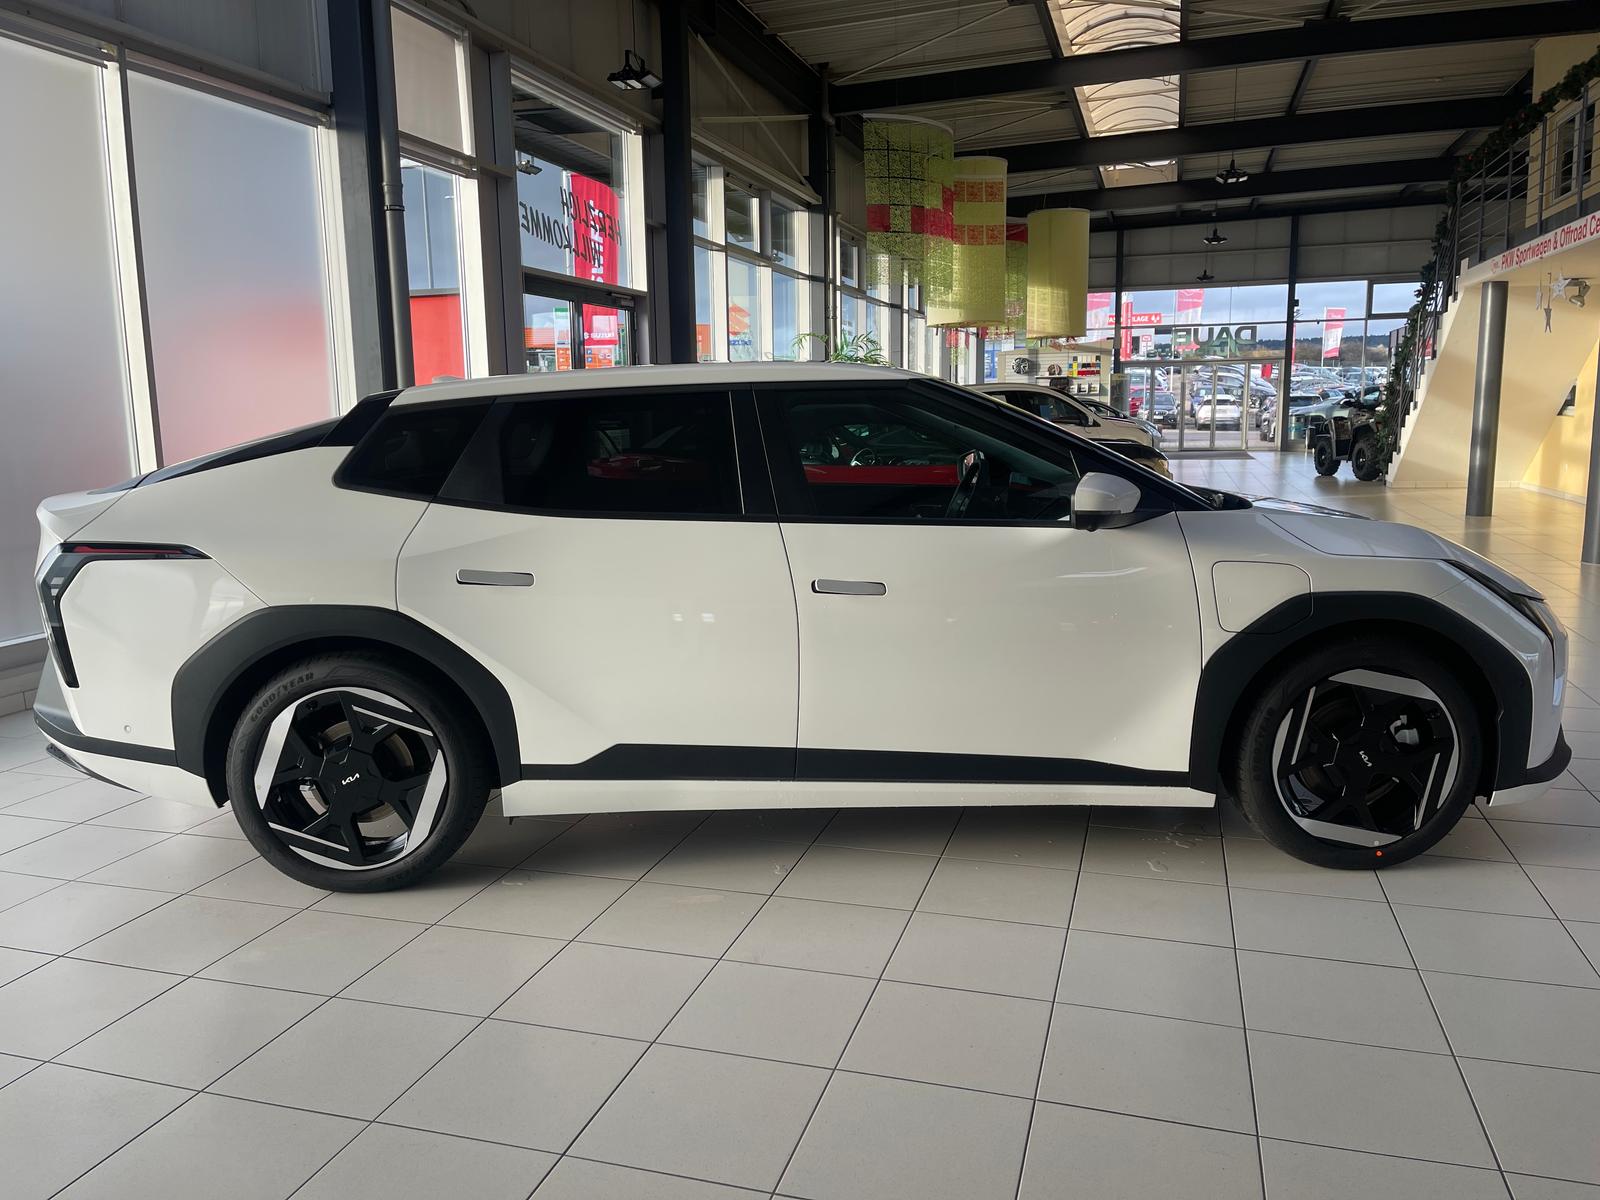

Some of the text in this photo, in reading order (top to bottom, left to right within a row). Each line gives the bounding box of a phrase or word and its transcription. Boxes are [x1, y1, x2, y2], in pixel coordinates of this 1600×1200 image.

[1501, 249, 1515, 271] PKW
[1515, 238, 1552, 268] Sportwagen
[1553, 232, 1558, 250] &
[1560, 219, 1588, 248] Offroad
[251, 671, 314, 722] GOODYEAR
